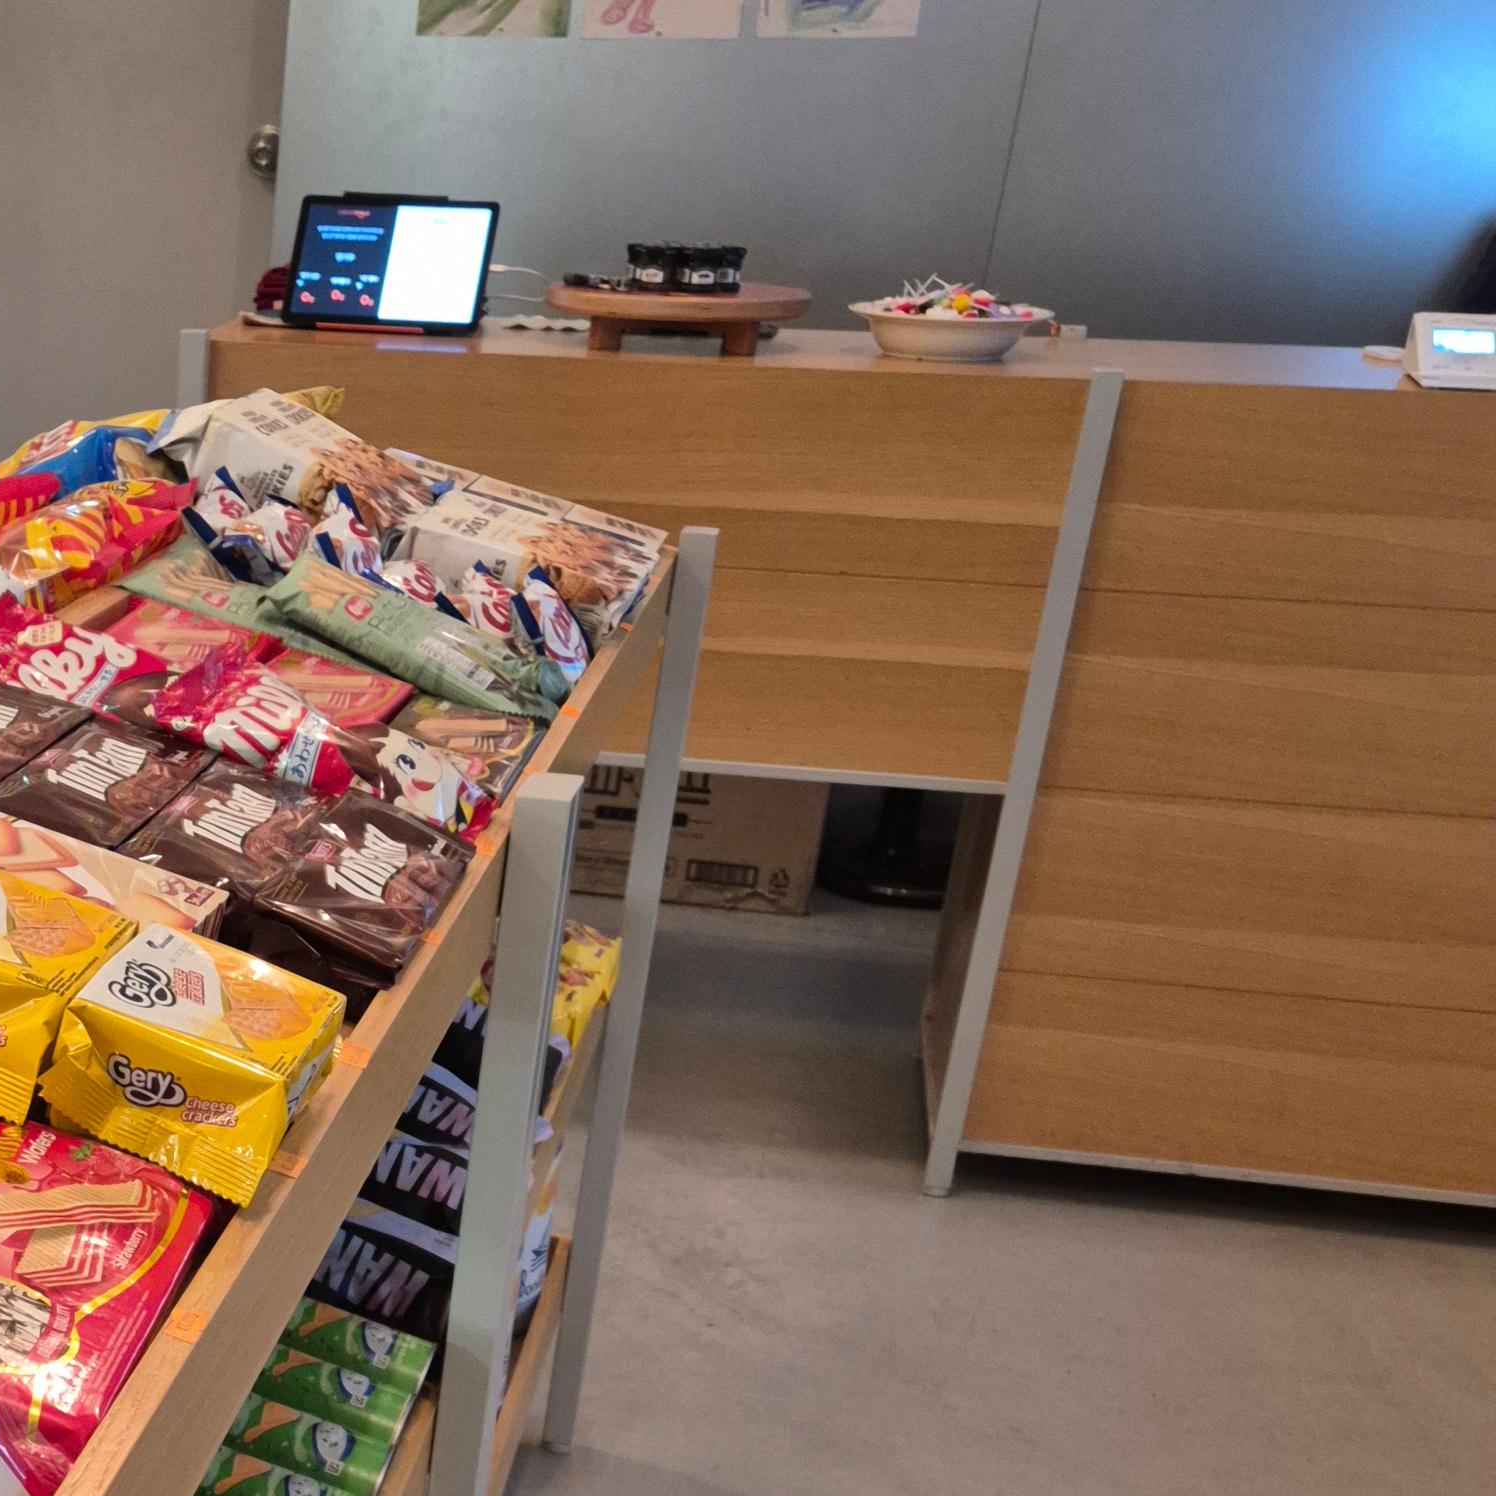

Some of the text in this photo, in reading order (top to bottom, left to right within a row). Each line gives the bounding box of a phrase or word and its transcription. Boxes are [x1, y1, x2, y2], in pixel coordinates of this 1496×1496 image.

[47, 738, 148, 801] Tim Tam
[183, 783, 277, 854] Tim Tam
[325, 823, 408, 904] Tim Tam
[108, 960, 177, 1009] Gery
[107, 1053, 188, 1107] Gery
[181, 1109, 239, 1128] crackers
[185, 1096, 235, 1114] Cheese
[18, 1129, 57, 1166] Wafers
[113, 1227, 148, 1272] Strawberry
